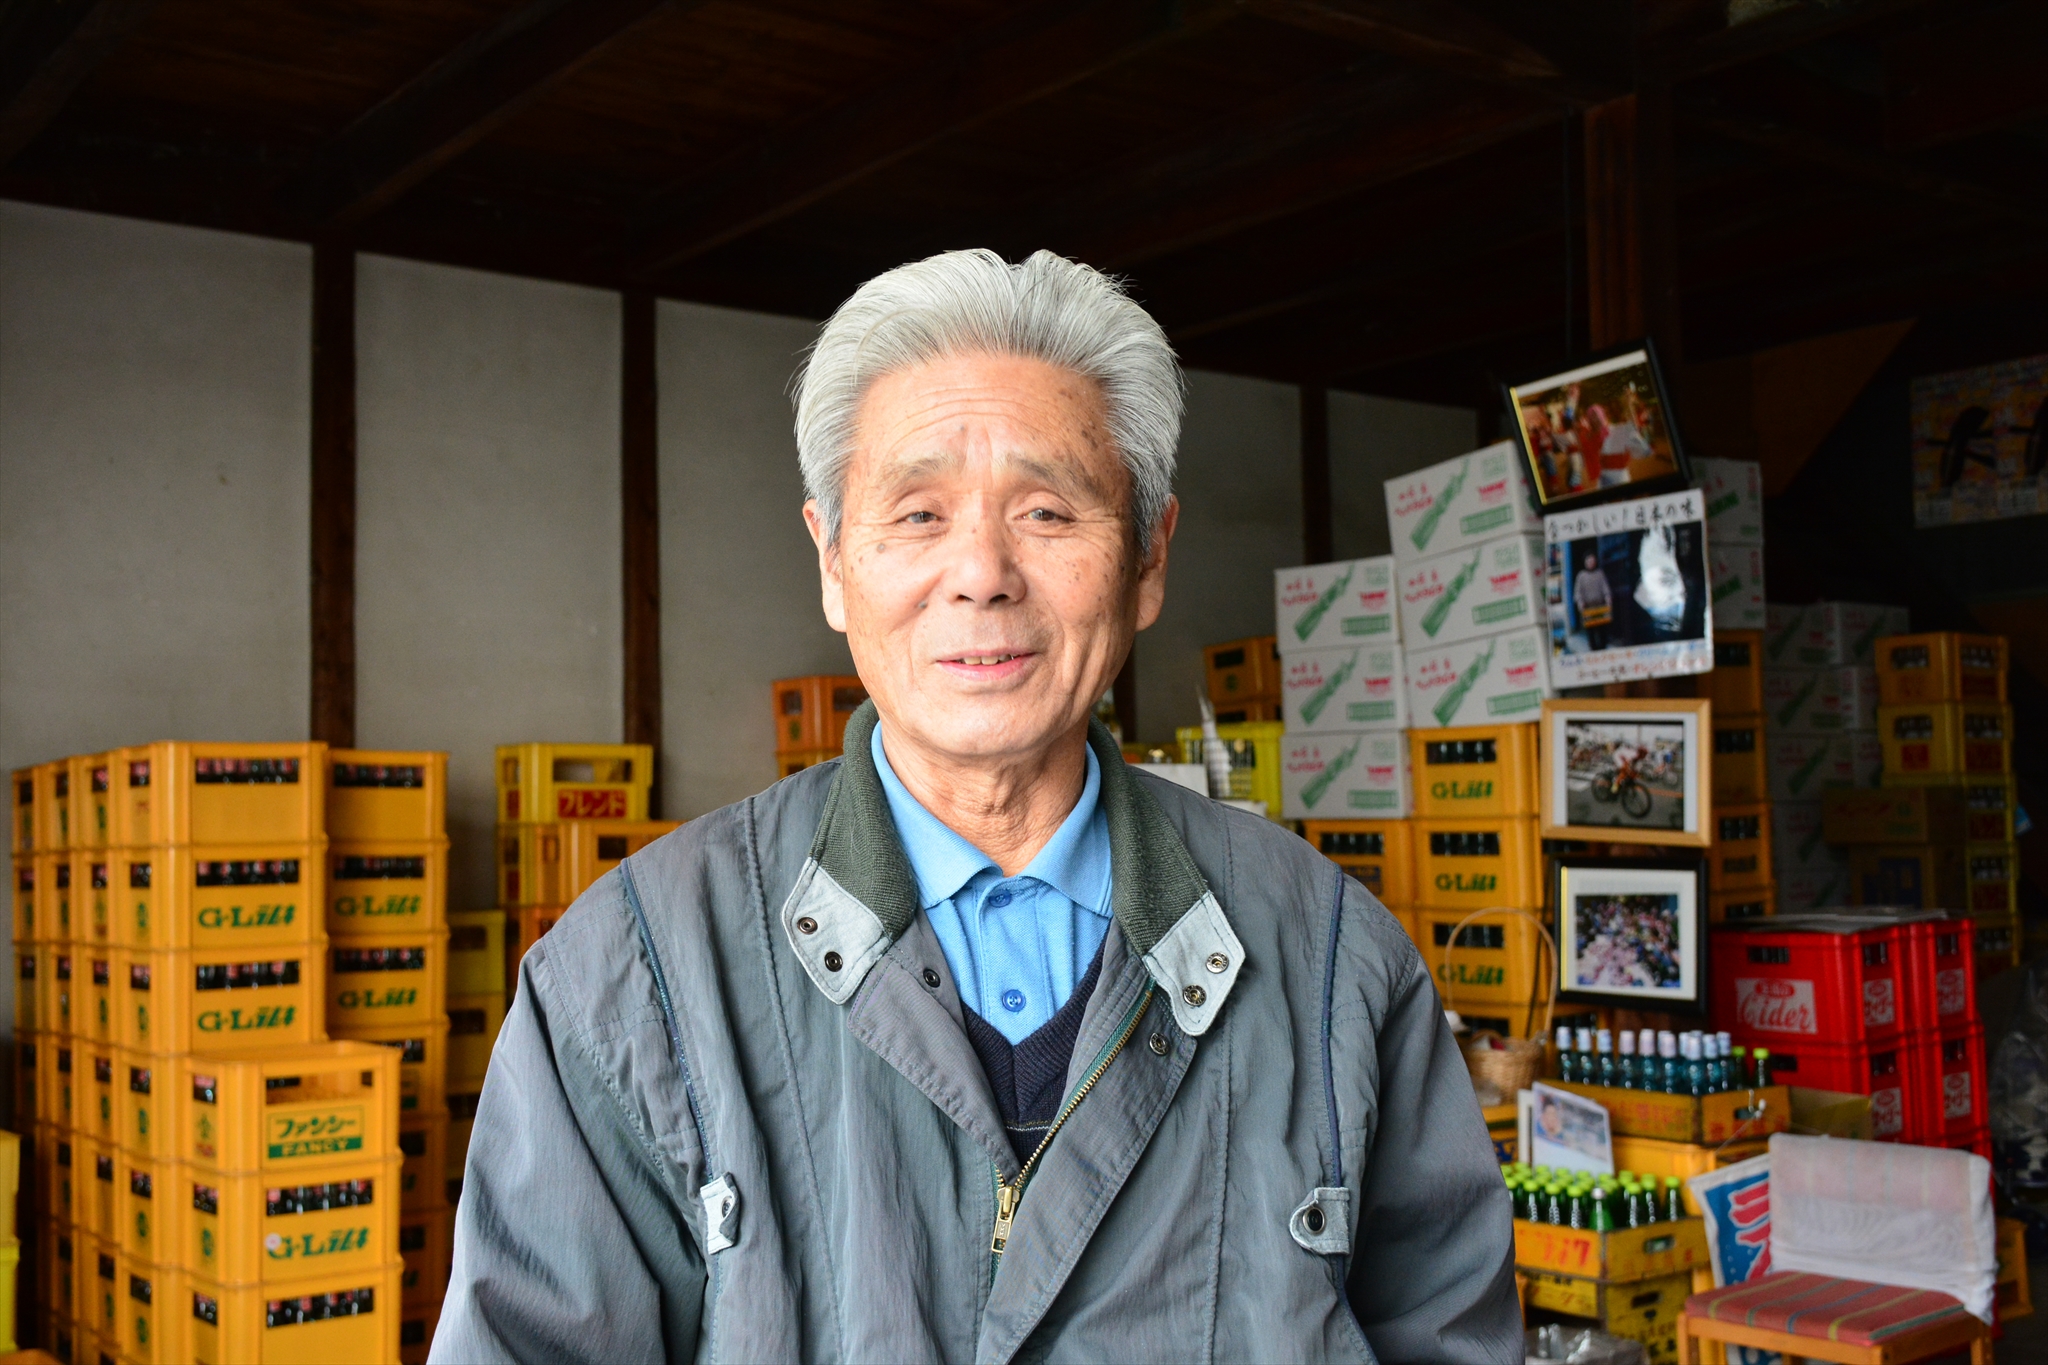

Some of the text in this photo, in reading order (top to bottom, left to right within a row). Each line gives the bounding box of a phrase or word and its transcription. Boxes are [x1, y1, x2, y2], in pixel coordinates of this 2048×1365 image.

[560, 791, 629, 817] フレンド
[1740, 991, 1810, 1030] Cider
[276, 1115, 357, 1139] ファンシー
[283, 1139, 346, 1157] FANCY
